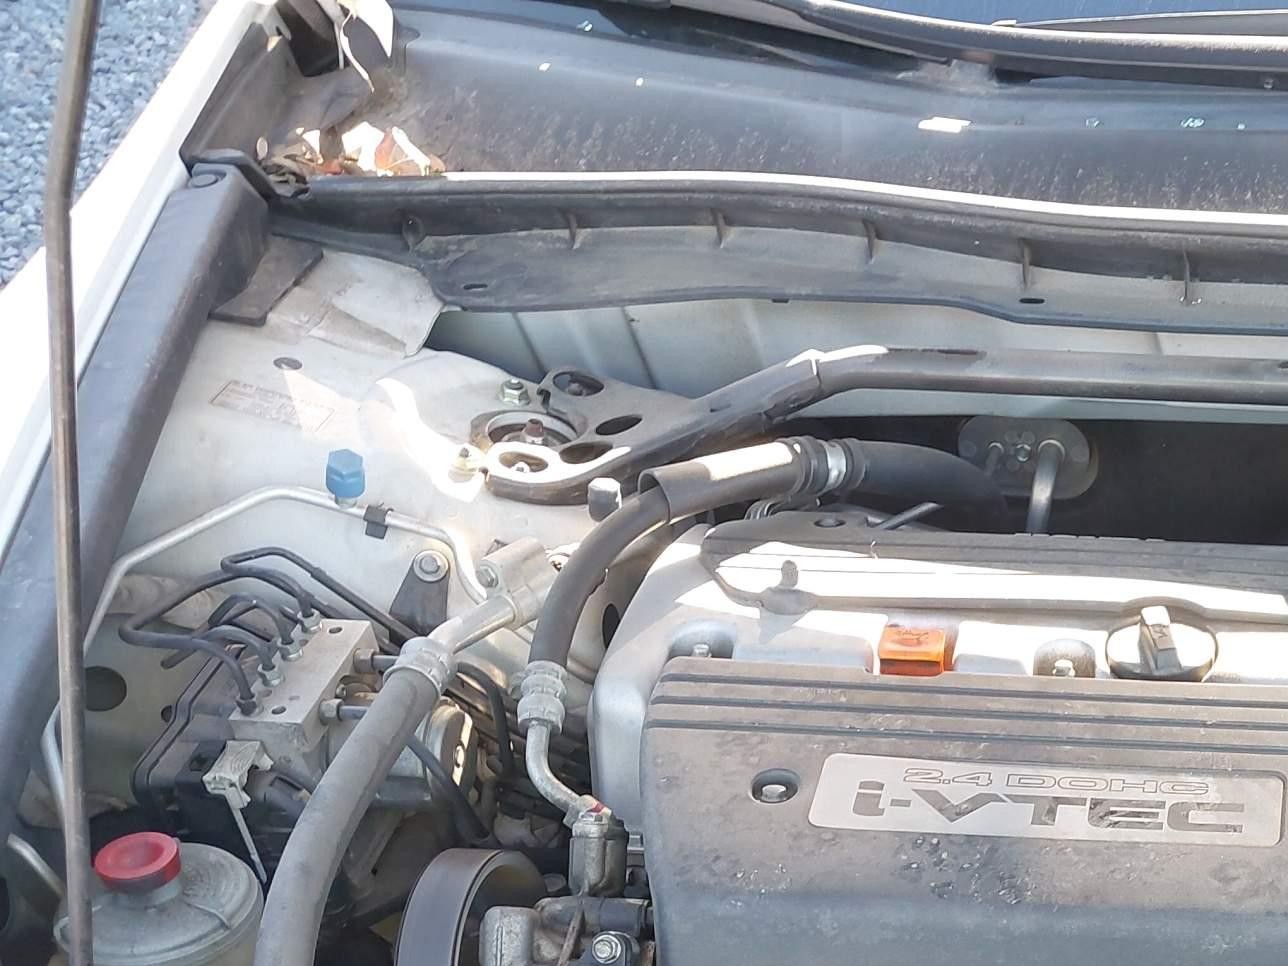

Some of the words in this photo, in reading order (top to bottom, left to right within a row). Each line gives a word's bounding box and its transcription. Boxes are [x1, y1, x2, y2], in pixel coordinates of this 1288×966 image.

[903, 767, 994, 787] 2.4
[1005, 773, 1209, 796] DOHC
[852, 780, 1245, 834] i-VTEC
